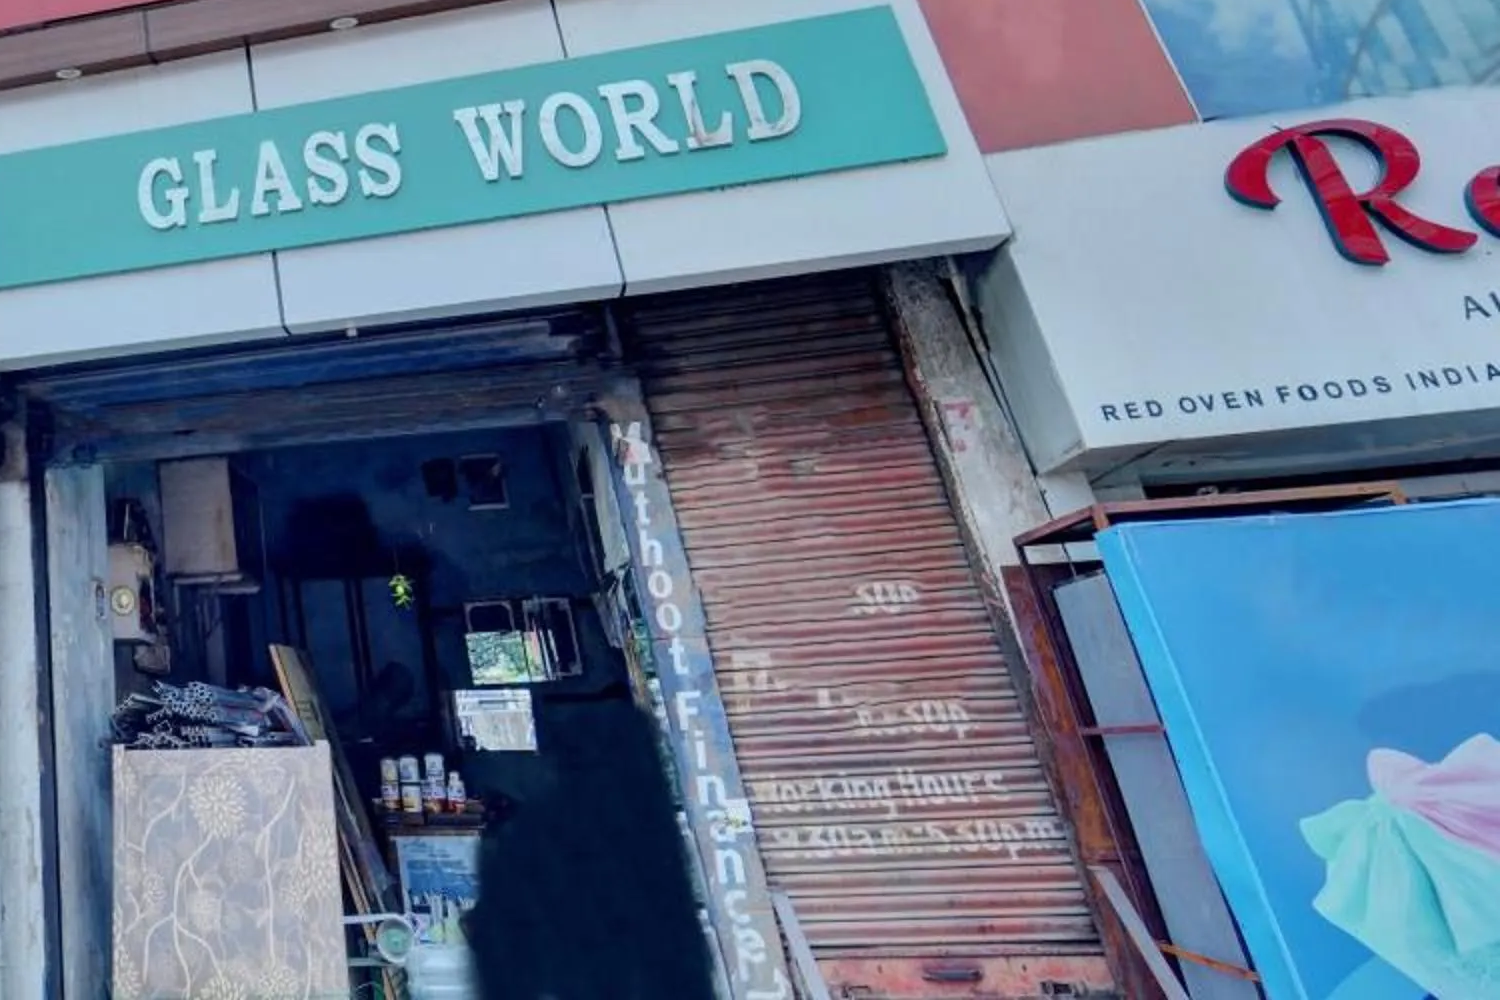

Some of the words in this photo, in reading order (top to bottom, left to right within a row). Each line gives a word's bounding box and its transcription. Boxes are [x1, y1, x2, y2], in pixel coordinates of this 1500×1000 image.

[137, 121, 404, 232] GLASS
[454, 58, 804, 183] WORLD
[1101, 399, 1163, 423] RED
[1179, 388, 1266, 415] OVEN
[1276, 375, 1393, 405] FOODS
[1405, 361, 1500, 393] INDIA
